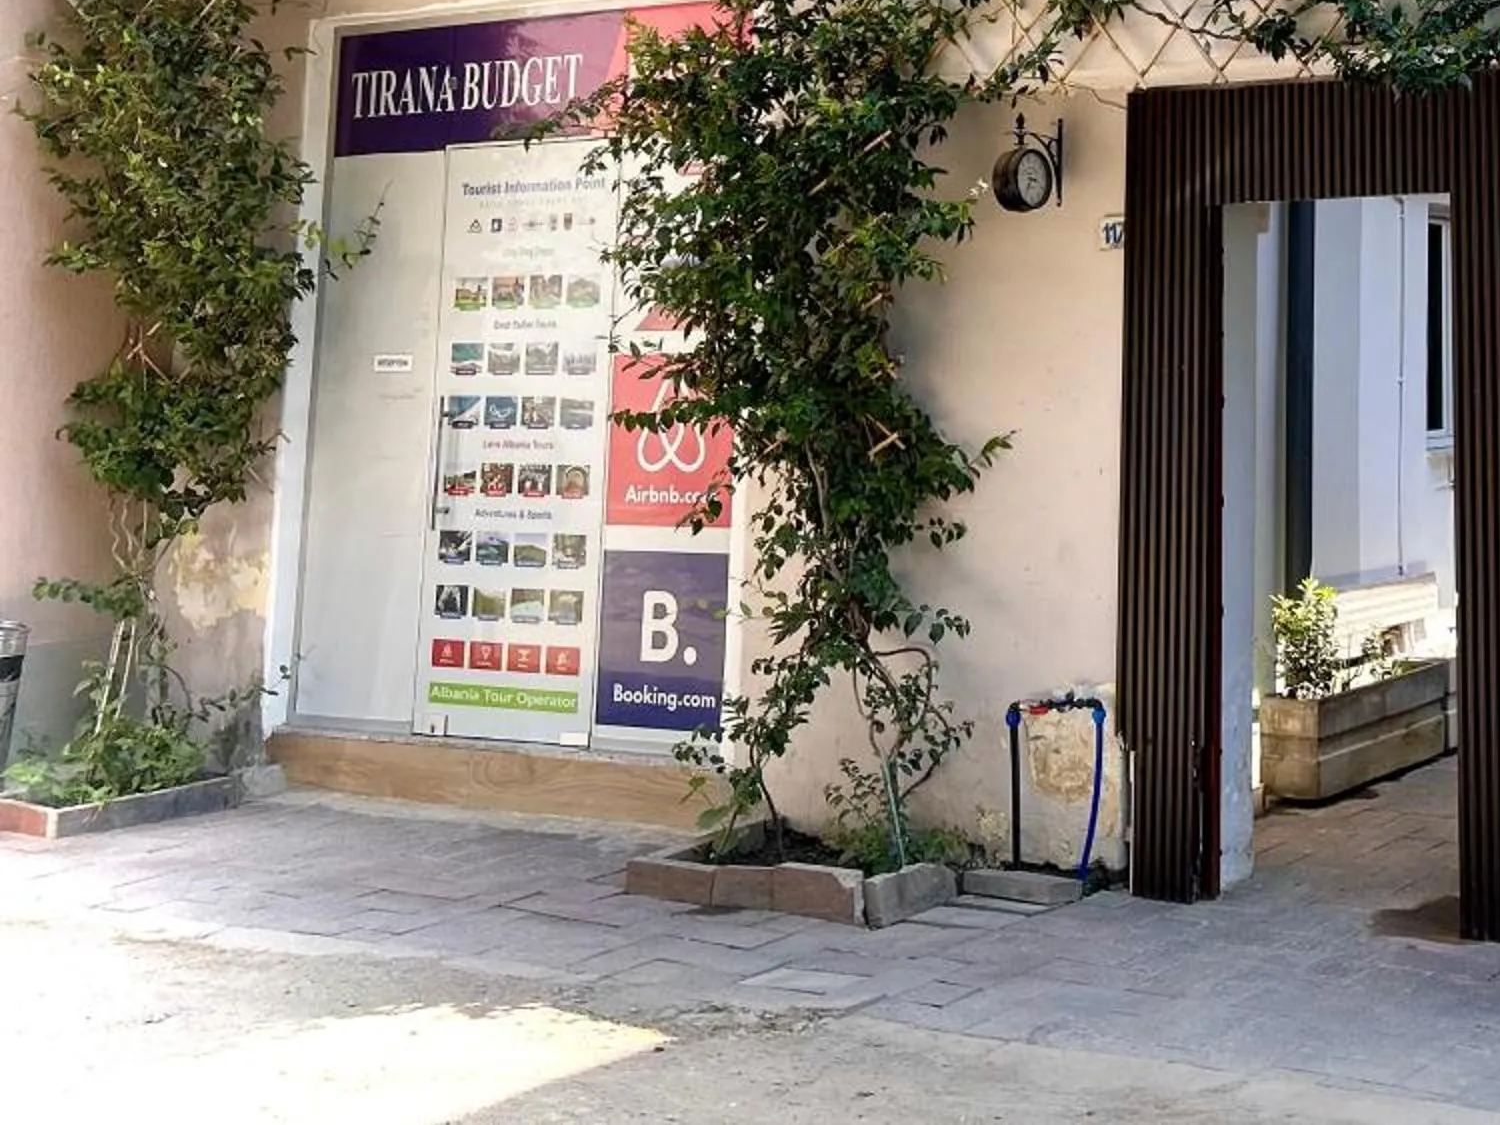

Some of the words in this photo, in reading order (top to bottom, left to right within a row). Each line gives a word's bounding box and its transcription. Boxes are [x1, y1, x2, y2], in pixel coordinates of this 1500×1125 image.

[352, 66, 455, 119] TIRANA
[461, 53, 584, 111] BUDGET
[462, 182, 501, 196] Tourist
[504, 178, 572, 194] Information
[575, 177, 606, 191] Point
[431, 685, 480, 699] Albania
[483, 689, 513, 703] Tour
[516, 692, 577, 708] Operator
[612, 683, 717, 712] Booking.com
